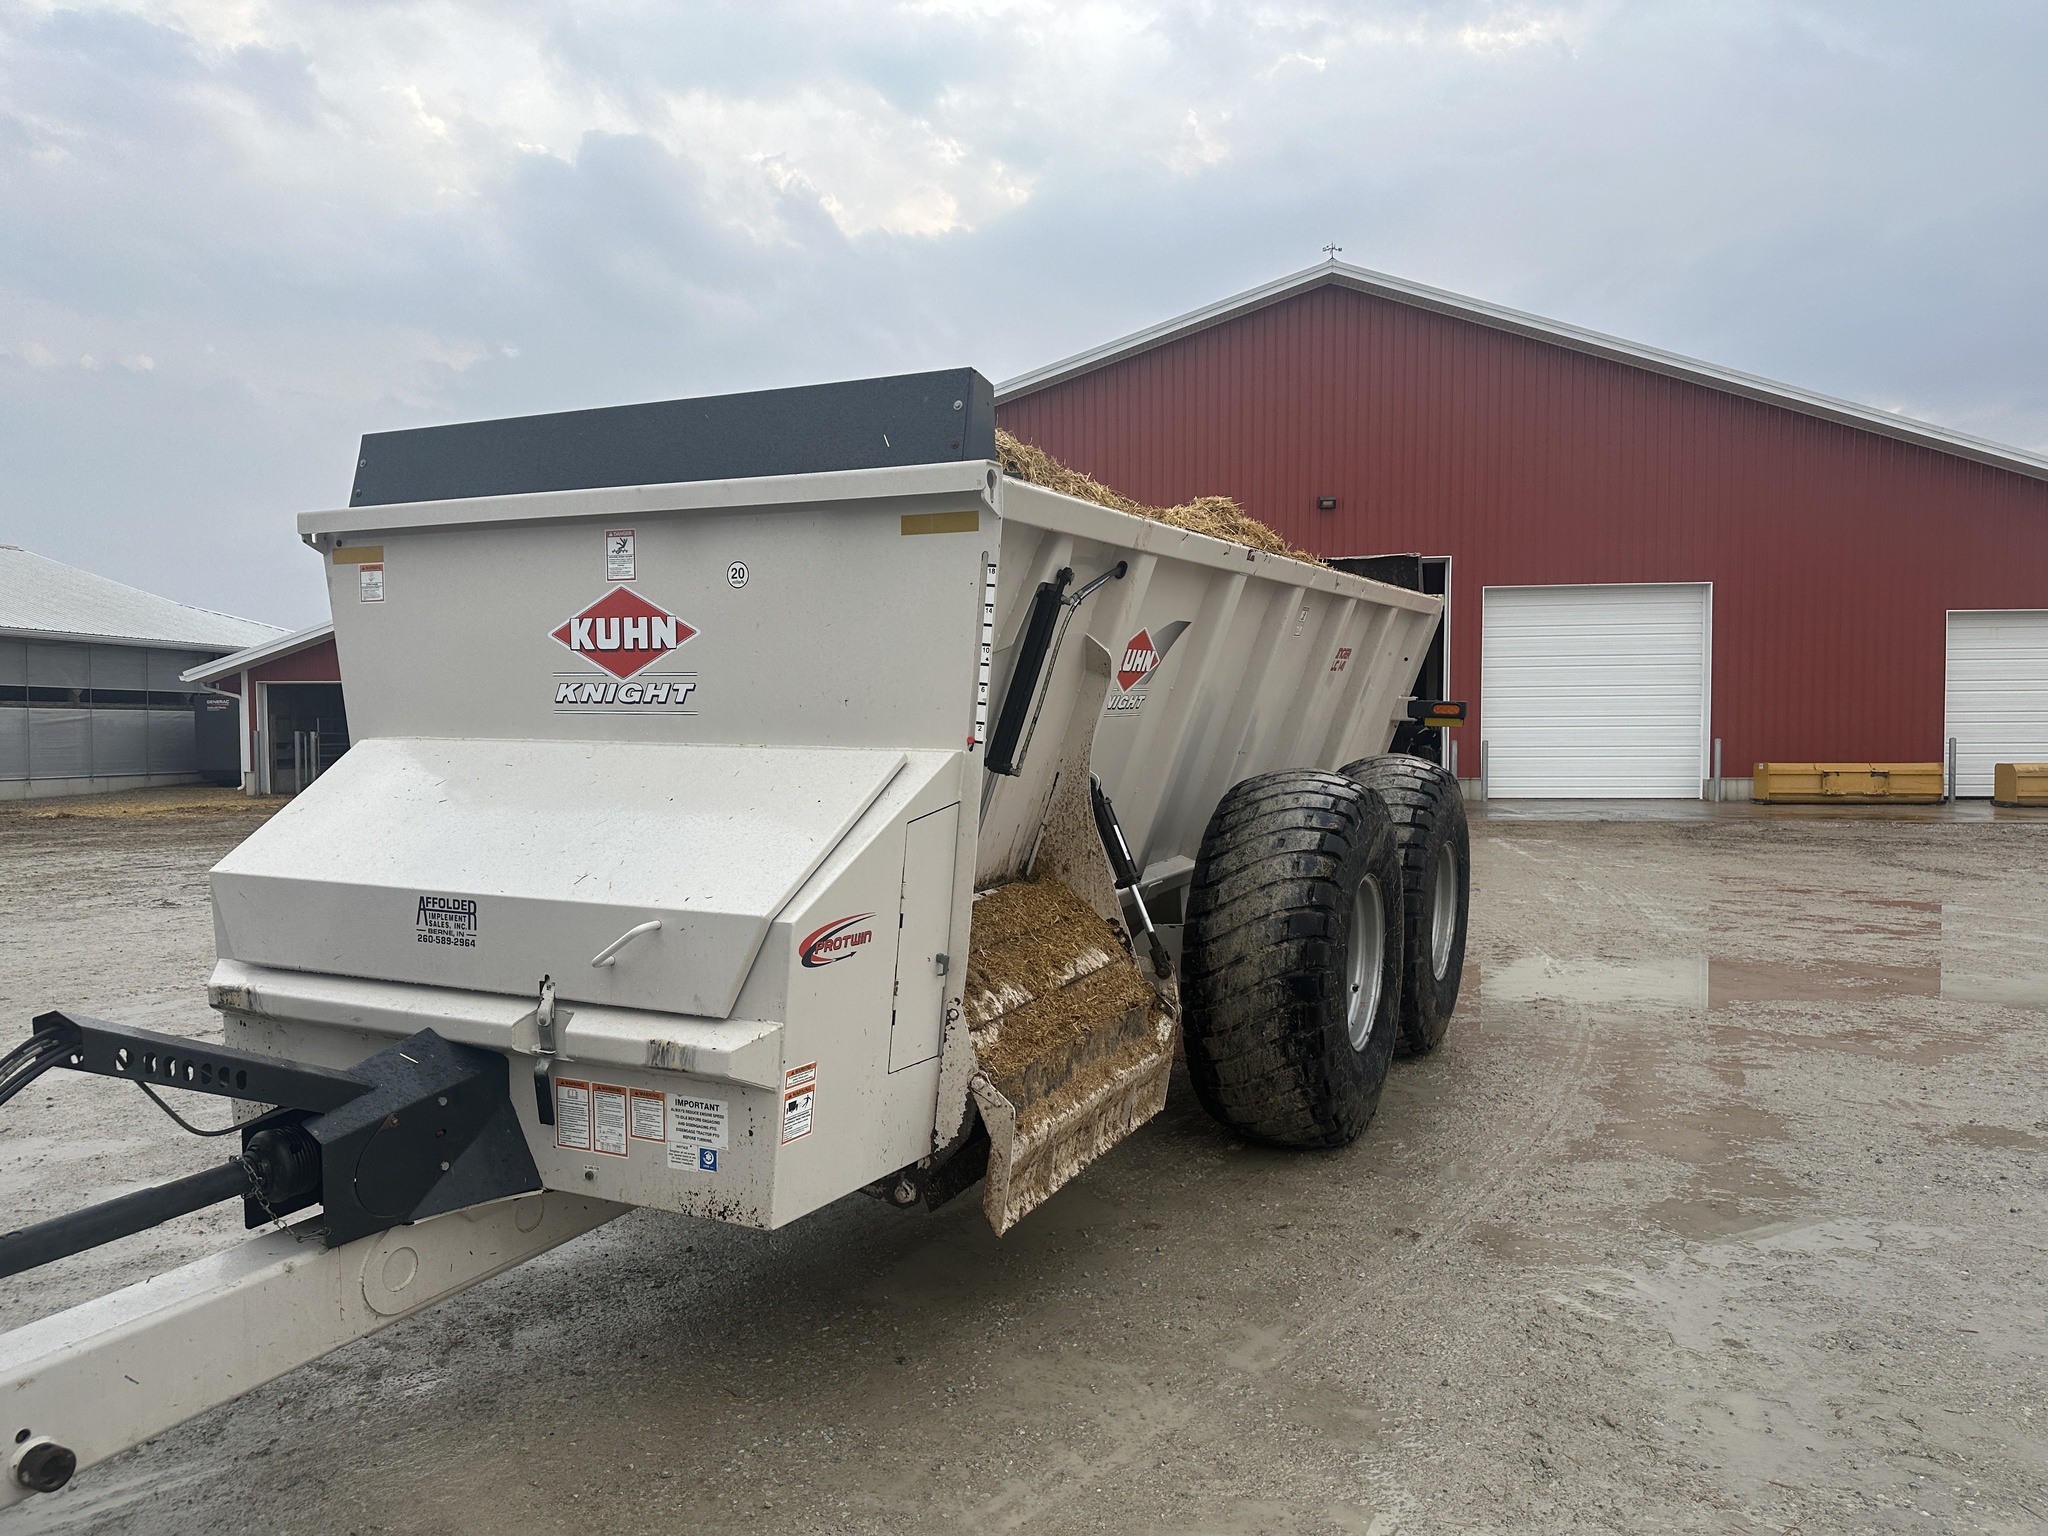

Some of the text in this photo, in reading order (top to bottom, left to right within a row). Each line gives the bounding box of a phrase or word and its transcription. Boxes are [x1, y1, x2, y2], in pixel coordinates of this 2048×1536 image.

[731, 567, 745, 580] 20
[570, 615, 677, 652] KUHN
[1119, 648, 1156, 673] UHN
[554, 682, 696, 705] KNIGHT
[416, 896, 477, 931] AFFOLDER
[428, 912, 467, 923] IMPLEMENT
[427, 928, 455, 938] BERNE,
[428, 920, 468, 930] SALES, INC.
[815, 930, 872, 955] PROTWIN
[674, 1098, 720, 1111] IMPORTANT
